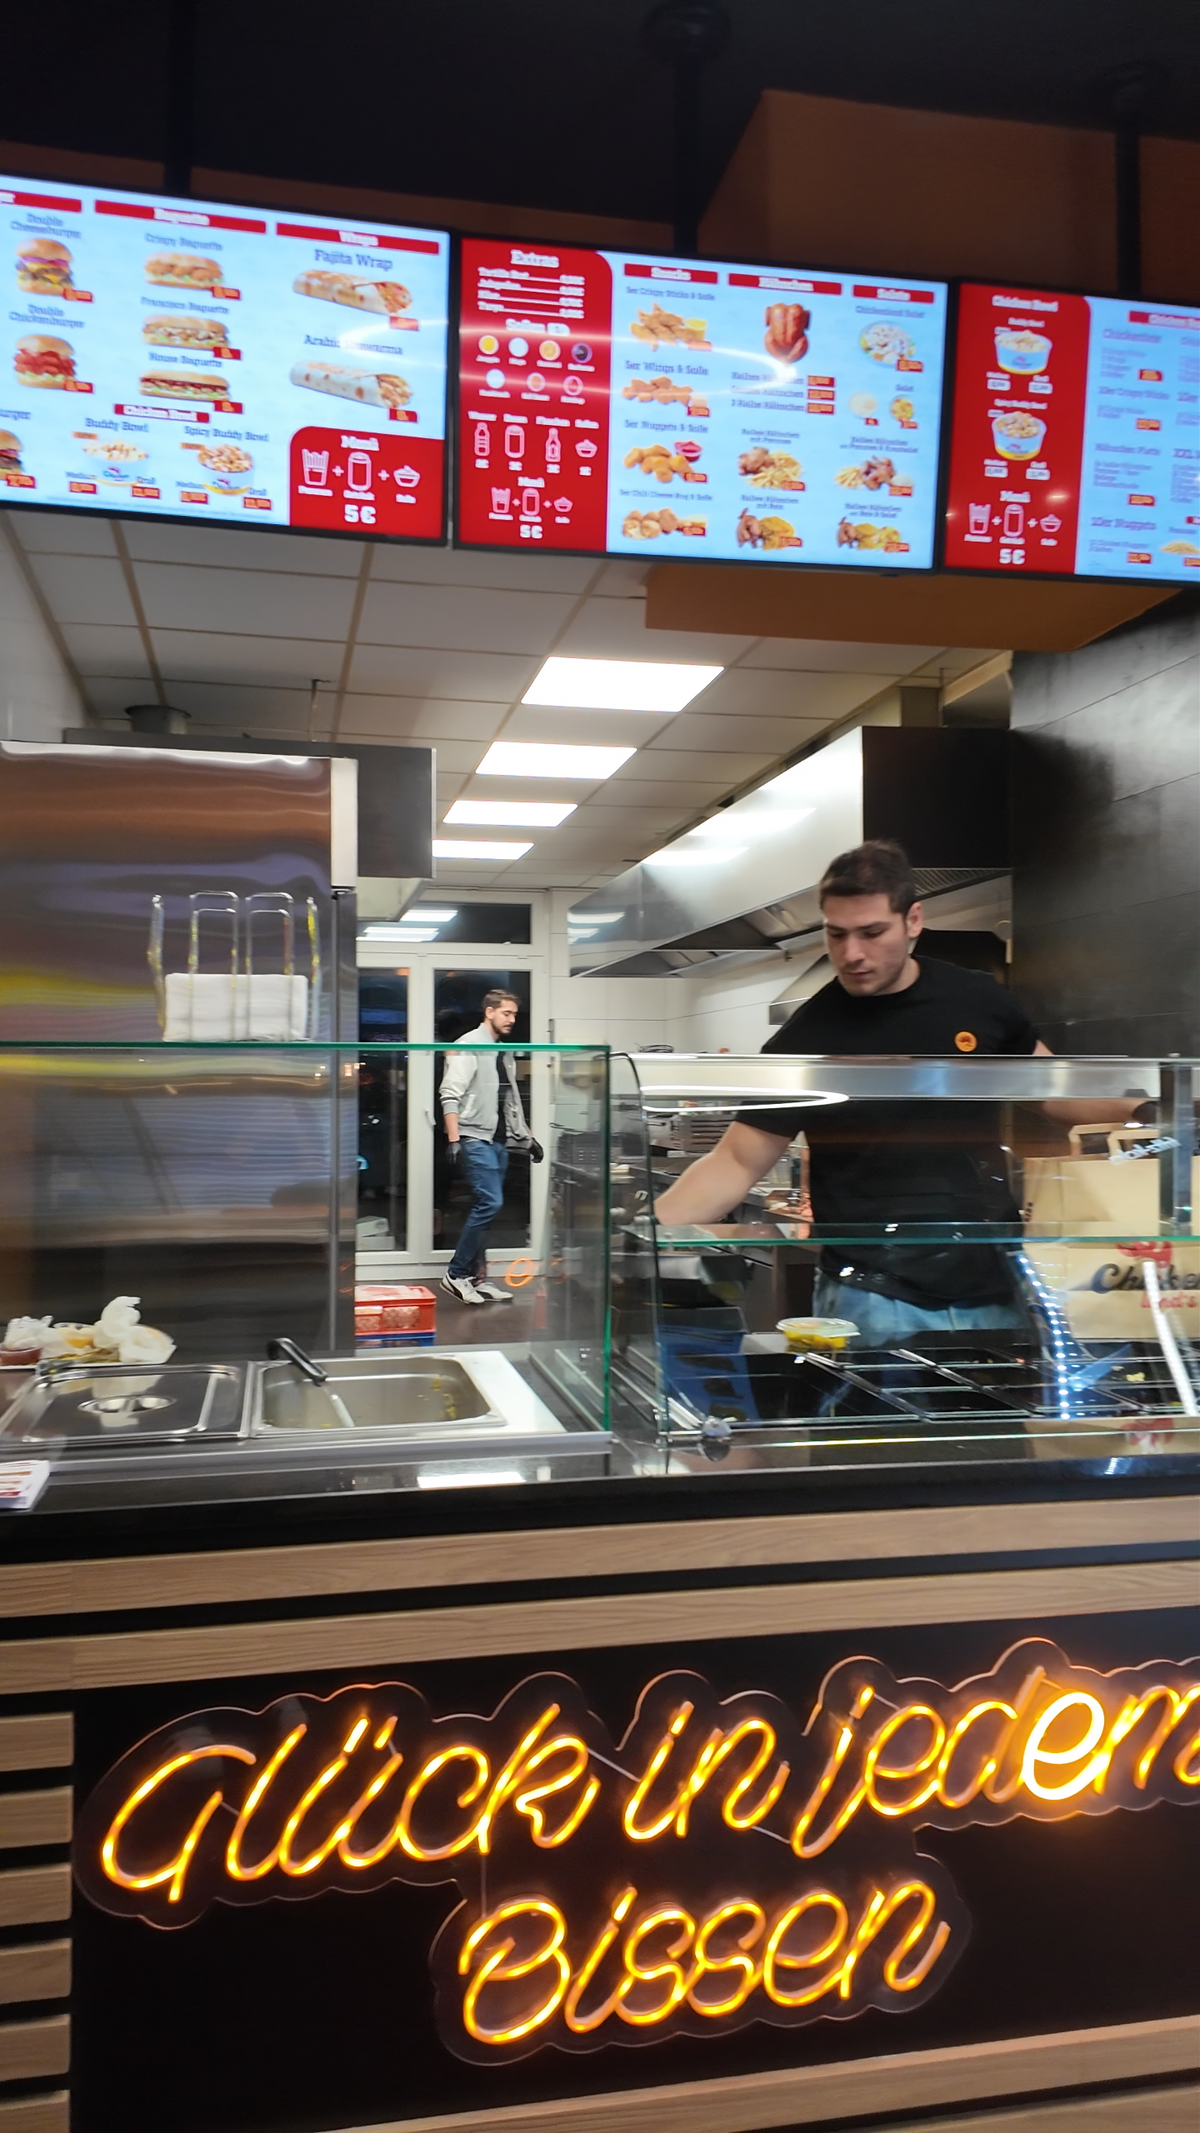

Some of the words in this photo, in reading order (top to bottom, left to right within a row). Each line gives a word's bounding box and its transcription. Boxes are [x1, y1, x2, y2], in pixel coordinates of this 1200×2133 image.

[314, 249, 353, 265] Fajita
[356, 254, 393, 271] Wrap
[344, 504, 377, 524] 5€
[999, 548, 1026, 564] 5€
[101, 1702, 601, 1903] Glück
[622, 1700, 791, 1841] in
[792, 1664, 1200, 1859] jedem
[457, 1883, 951, 2045] Bissen
